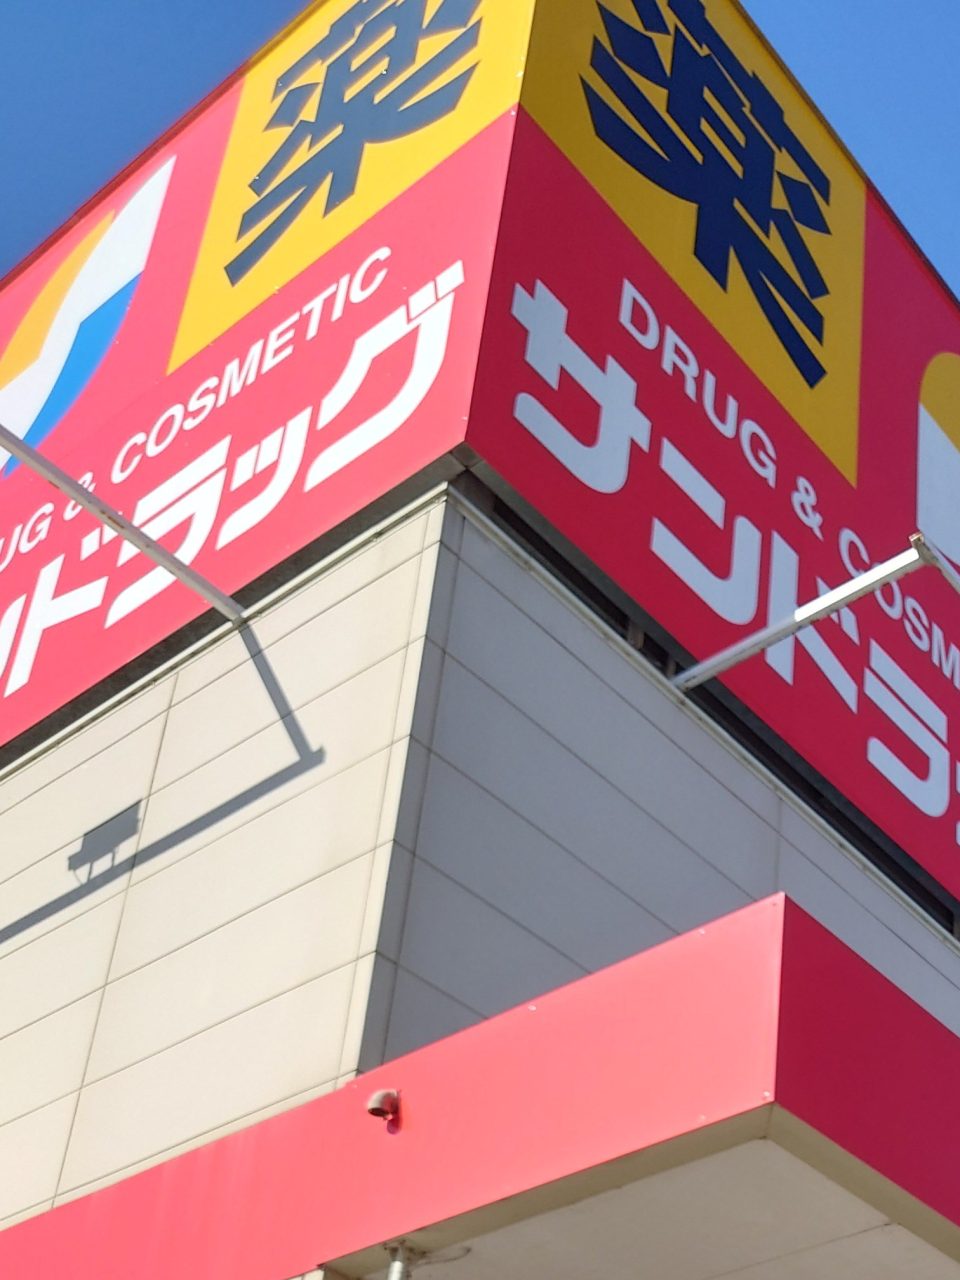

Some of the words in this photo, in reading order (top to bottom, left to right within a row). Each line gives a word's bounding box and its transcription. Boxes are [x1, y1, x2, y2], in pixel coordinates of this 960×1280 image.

[225, 0, 484, 287] 薬
[579, 0, 831, 389] 薬
[111, 246, 392, 485] COSMETIC
[619, 277, 777, 489] DRUG
[792, 477, 824, 539] &
